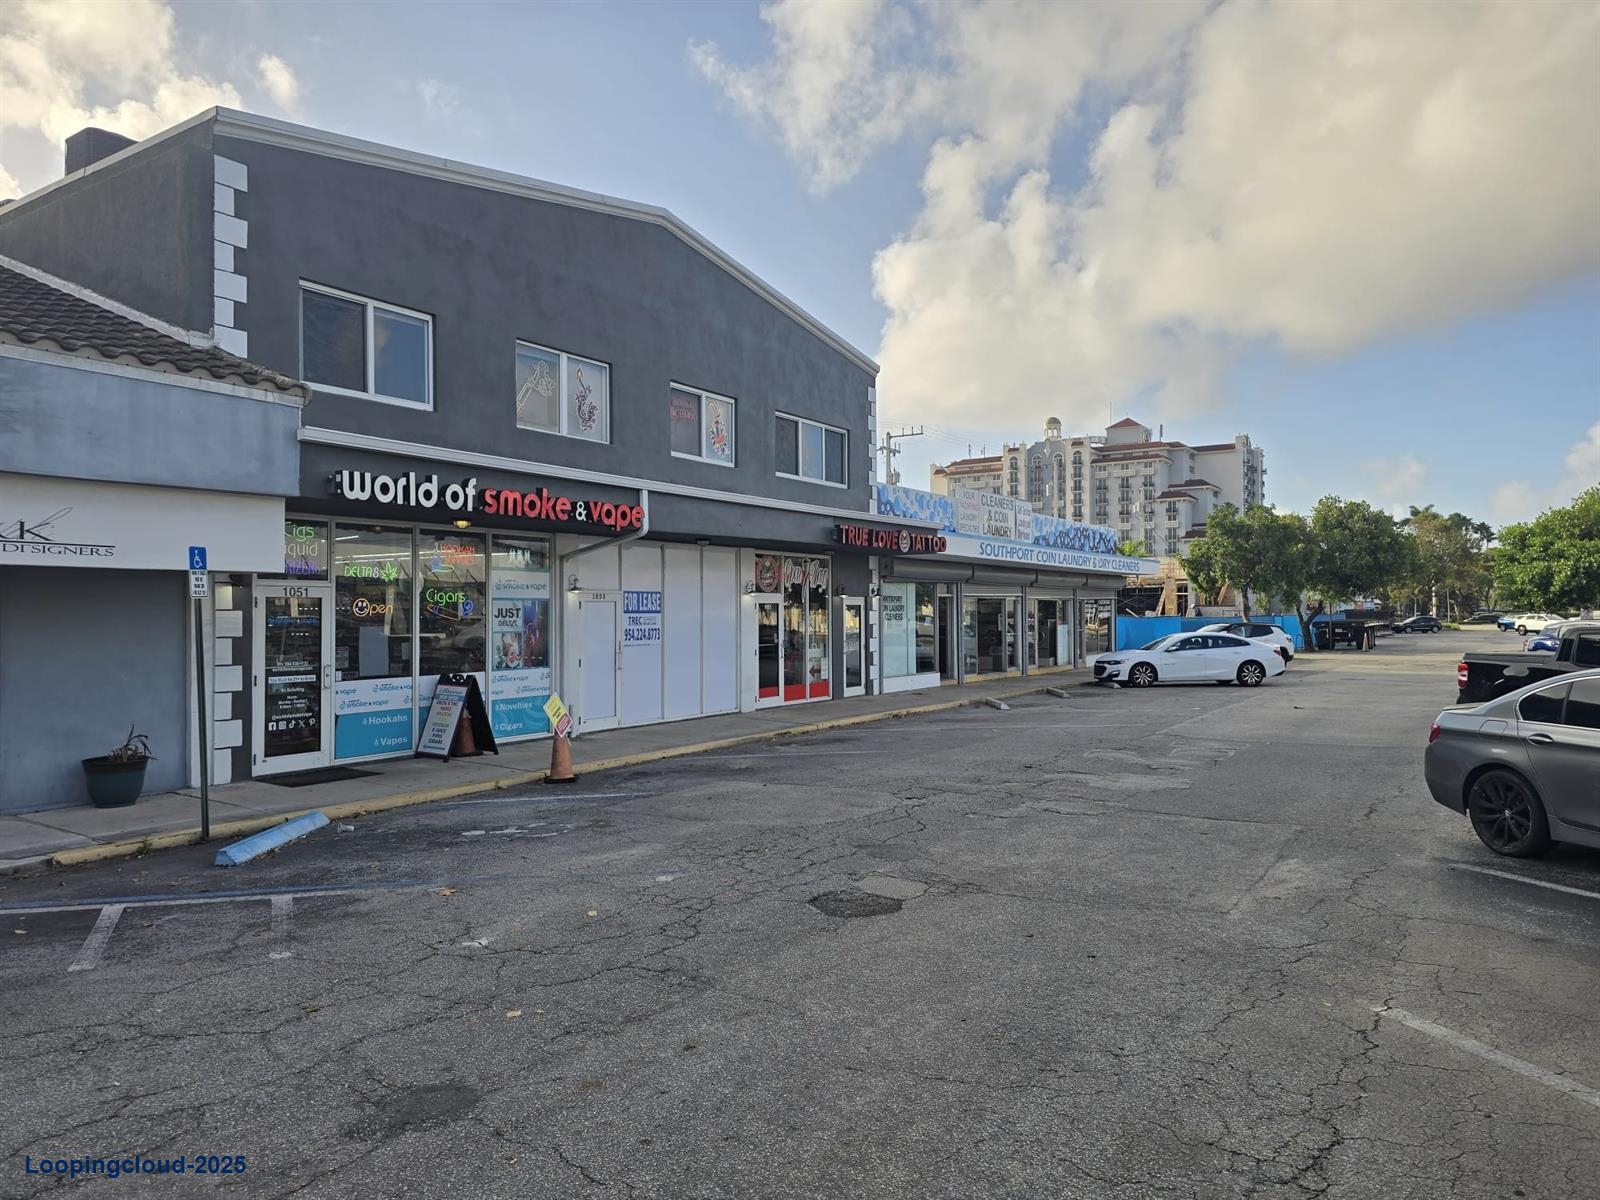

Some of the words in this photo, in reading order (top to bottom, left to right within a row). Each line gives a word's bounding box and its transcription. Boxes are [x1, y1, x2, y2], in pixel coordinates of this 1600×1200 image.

[445, 478, 477, 512] of
[484, 487, 572, 521] smoke
[575, 501, 587, 521] &
[589, 501, 645, 532] vape
[981, 494, 1014, 511] CLEANERS
[987, 509, 993, 522] &
[994, 510, 1009, 524] COIN
[982, 523, 1012, 538] LAUNDRY
[840, 524, 869, 547] TRUE
[872, 528, 898, 551] LOVE
[911, 533, 947, 552] TATTOO
[2, 543, 114, 557] DESIGNERS
[979, 541, 1033, 562] SOUTHPORT
[1036, 550, 1057, 564] COIN
[1058, 553, 1092, 568] LAUNDRY
[1092, 558, 1097, 568] &
[1099, 558, 1111, 569] DRY
[1111, 559, 1140, 572] CLEANERS
[282, 587, 309, 597] 1051
[426, 588, 466, 606] Cigars
[624, 592, 638, 611] FOR
[640, 592, 661, 611] LEASE
[494, 607, 521, 619] JUST
[628, 616, 642, 626] TREC
[340, 687, 357, 695] vape
[500, 702, 532, 711] Novelties
[368, 714, 408, 725] Hookahs
[500, 722, 523, 731] Cigars
[380, 736, 408, 746] Vapes
